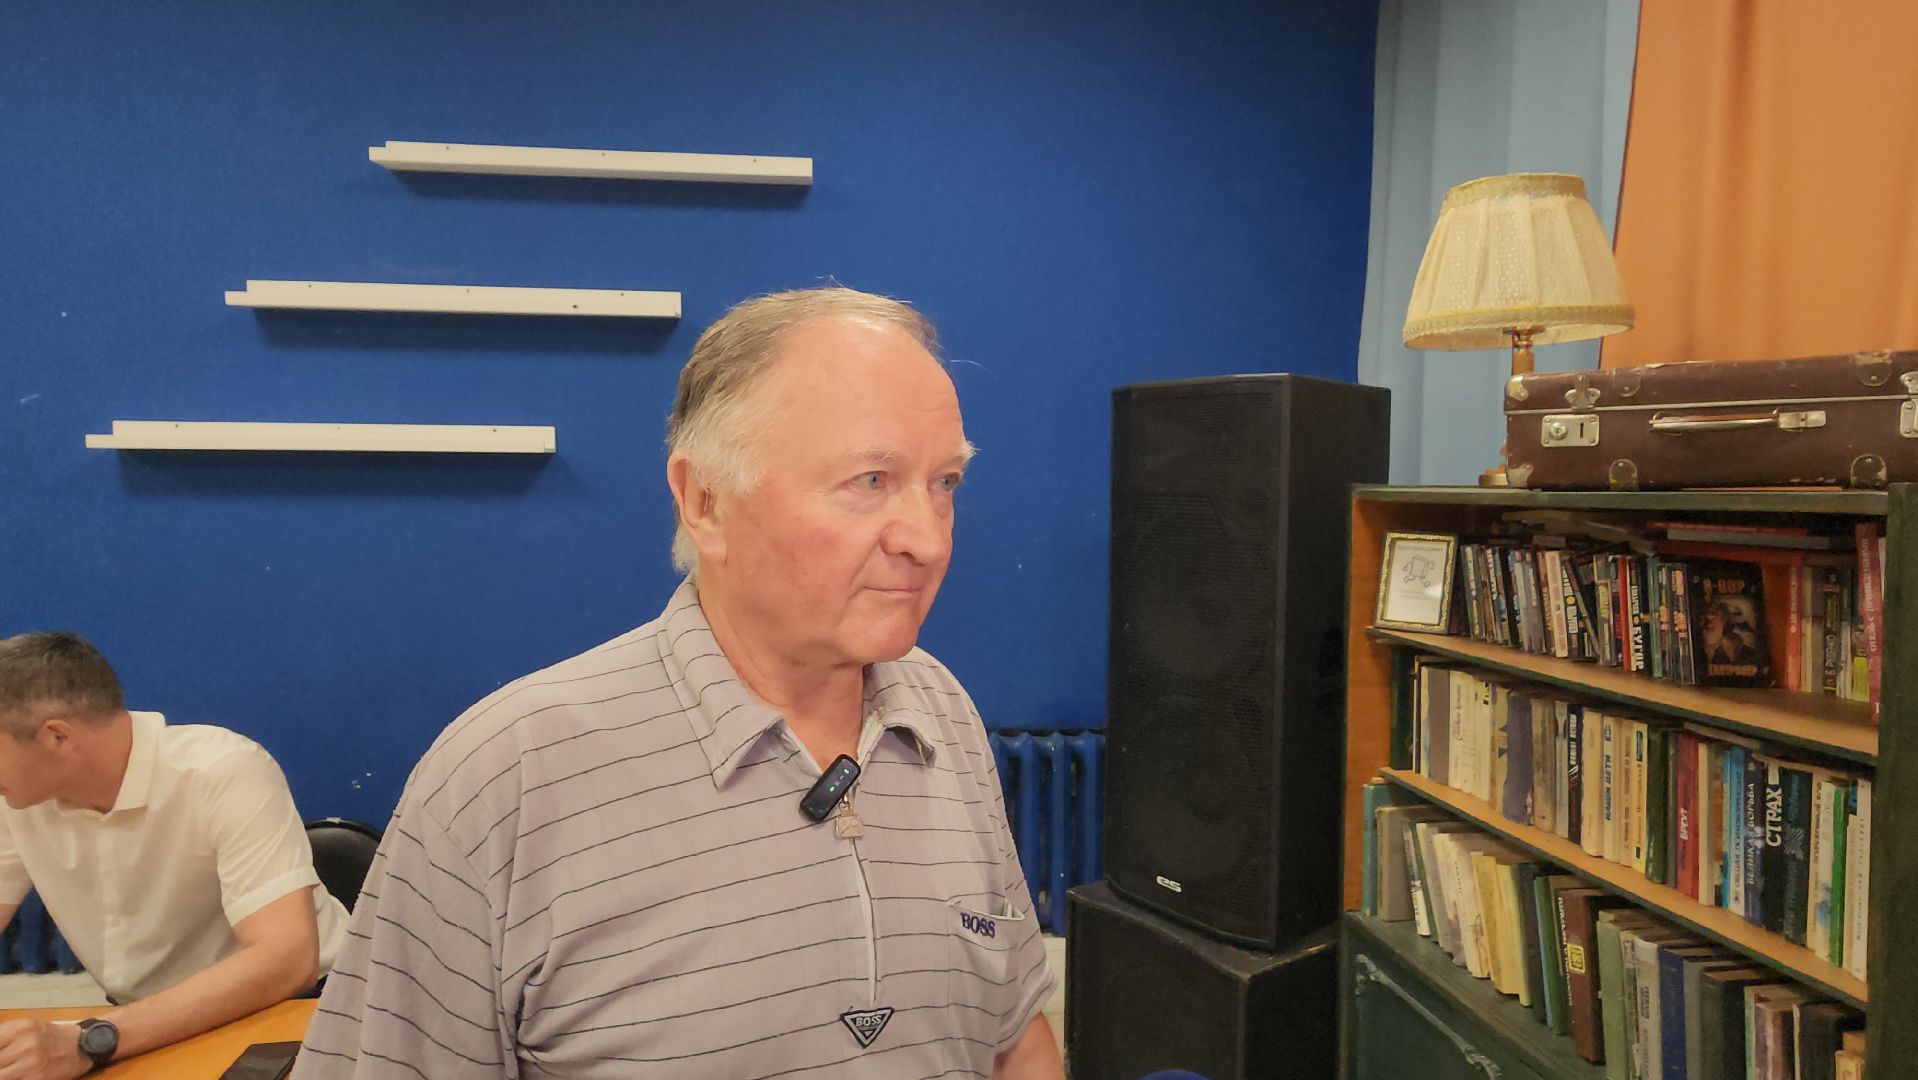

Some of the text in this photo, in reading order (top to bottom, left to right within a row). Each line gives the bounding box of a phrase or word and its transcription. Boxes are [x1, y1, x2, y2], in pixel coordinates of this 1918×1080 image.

[1747, 783, 1756, 829] БОРЬБА
[1765, 787, 1784, 847] СТРАХ
[960, 911, 996, 939] BOSS
[855, 1015, 882, 1027] BOSS
